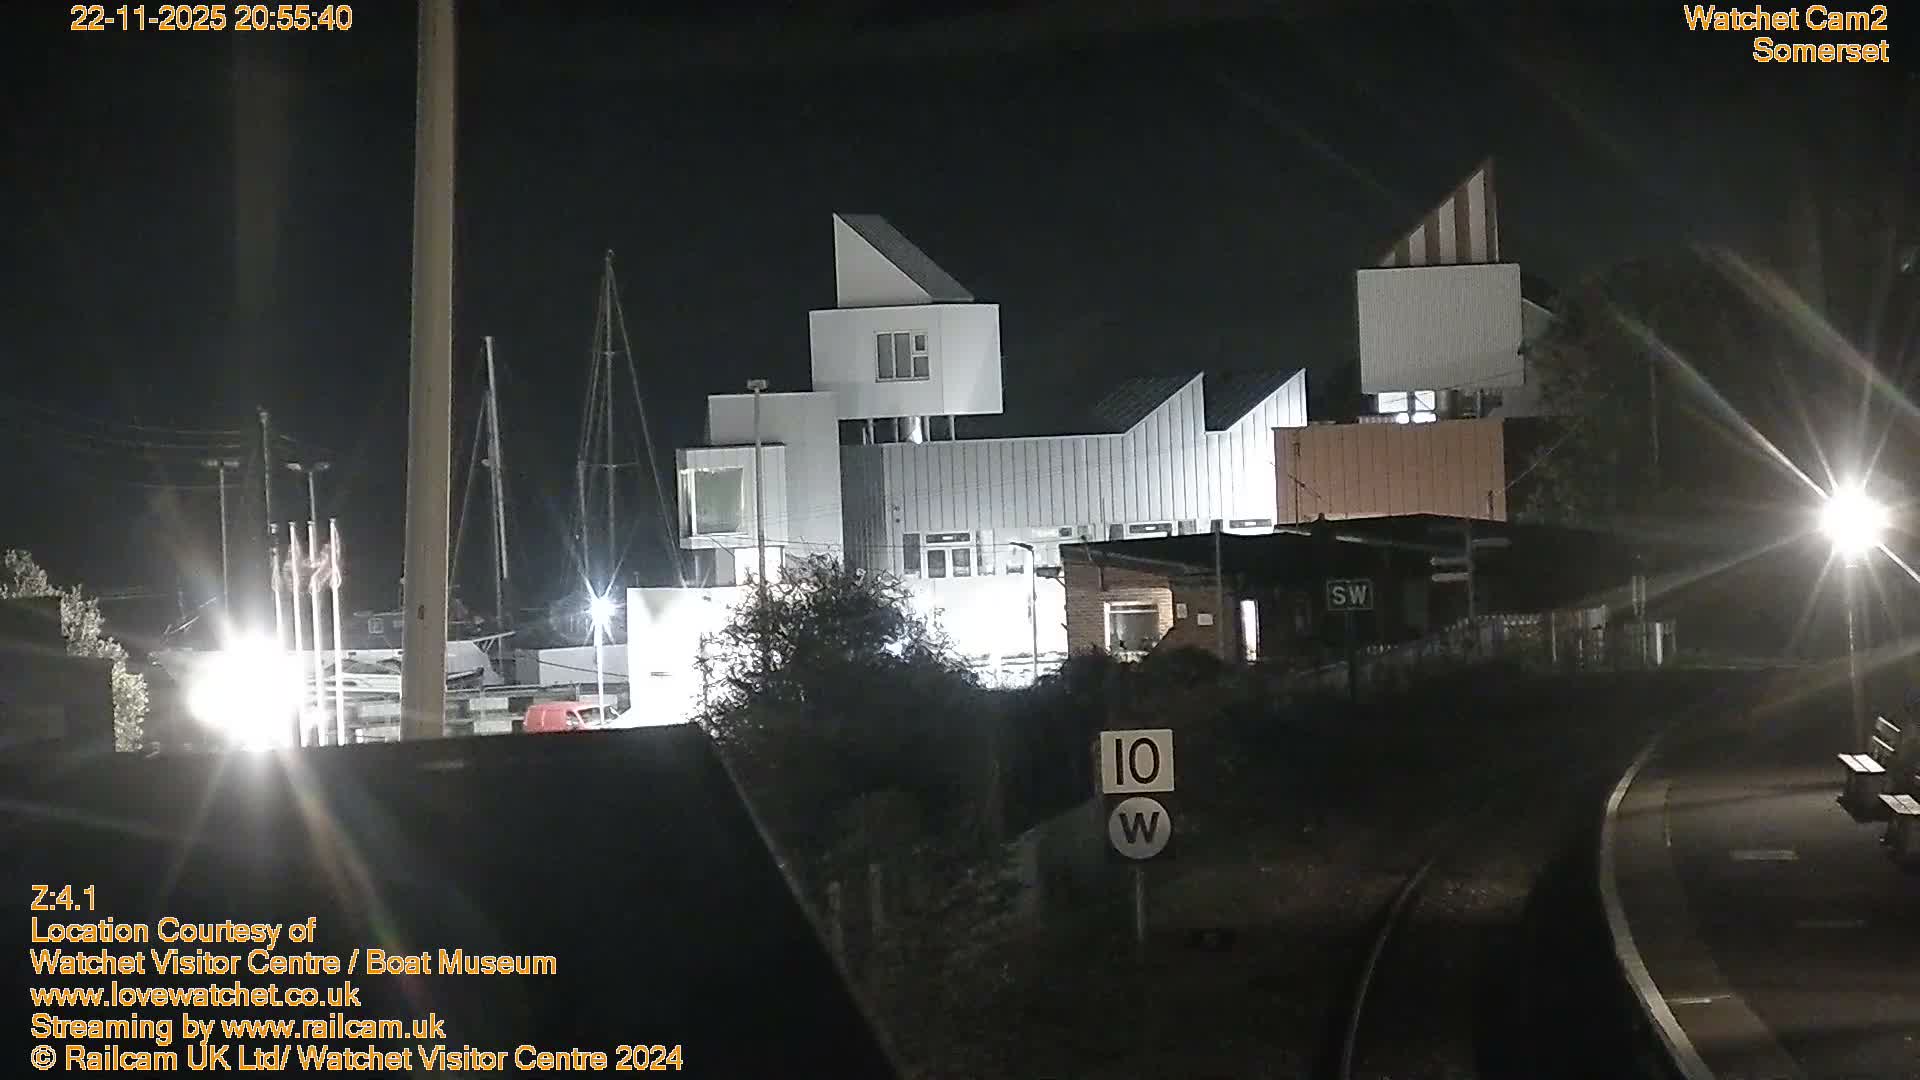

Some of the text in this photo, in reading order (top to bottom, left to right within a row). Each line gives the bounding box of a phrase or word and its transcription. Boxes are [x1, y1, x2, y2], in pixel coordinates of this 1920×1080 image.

[1332, 585, 1367, 605] SW
[1115, 737, 1160, 785] 10
[1119, 811, 1160, 844] W
